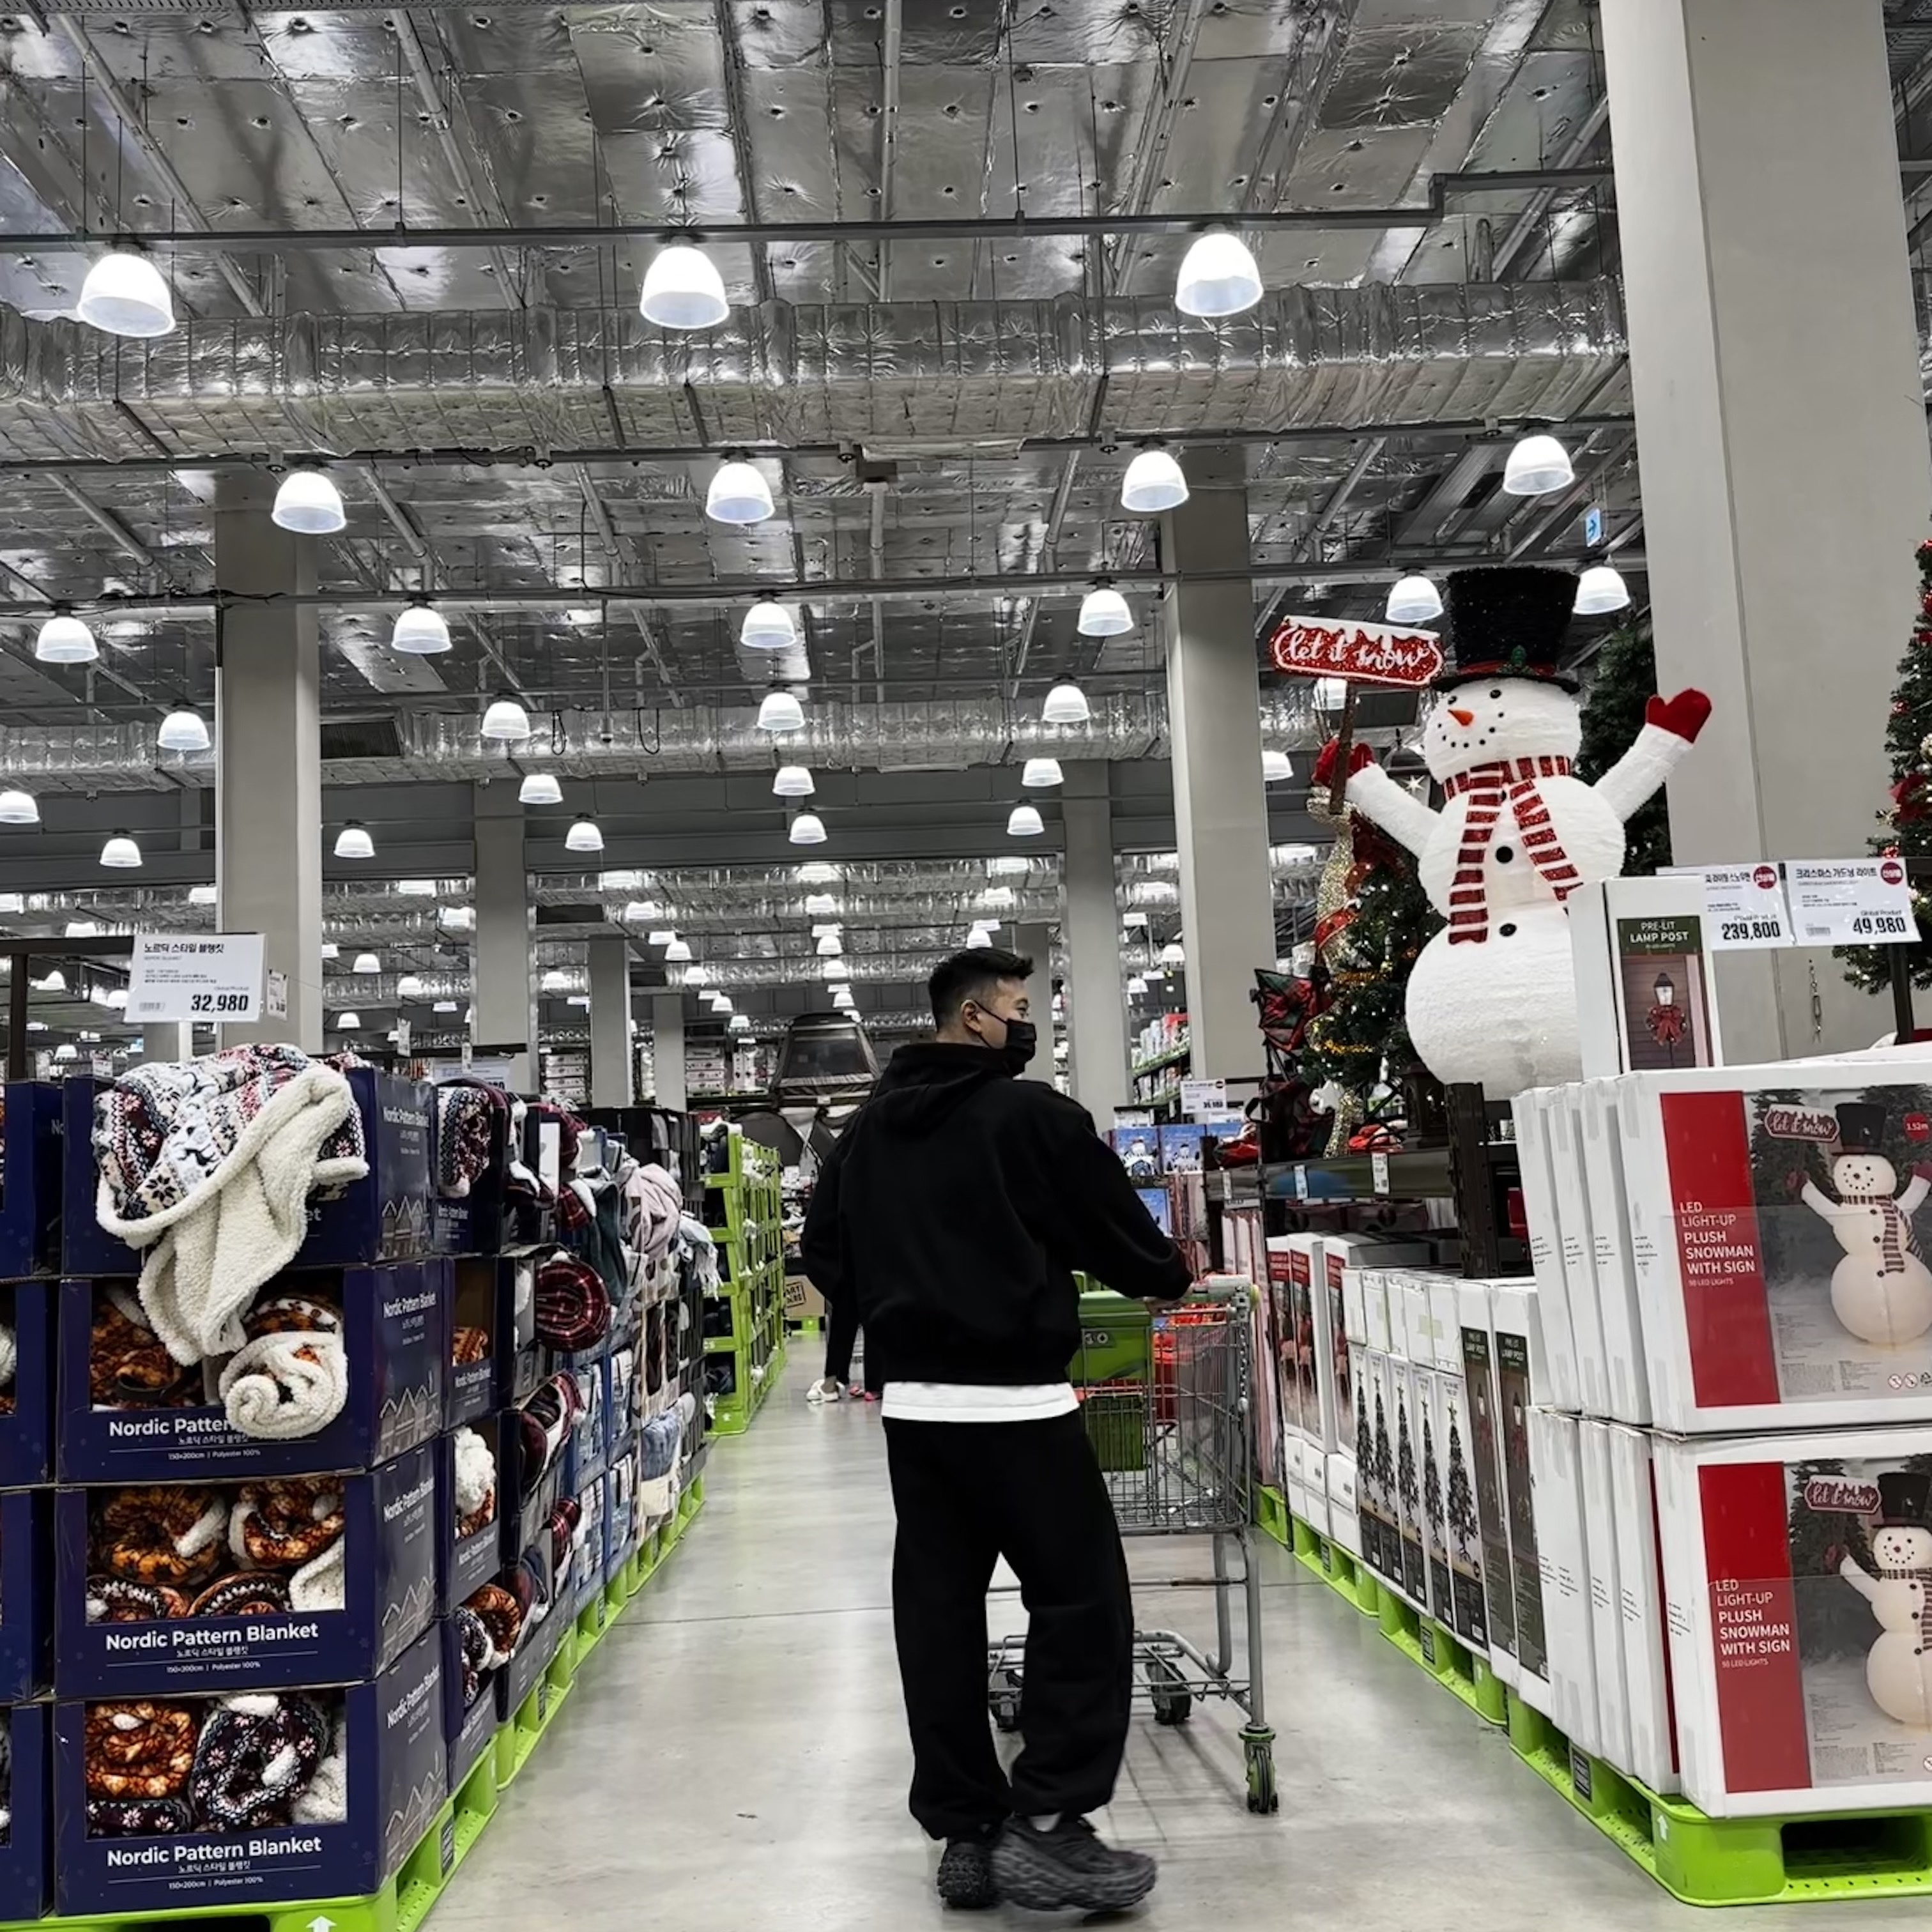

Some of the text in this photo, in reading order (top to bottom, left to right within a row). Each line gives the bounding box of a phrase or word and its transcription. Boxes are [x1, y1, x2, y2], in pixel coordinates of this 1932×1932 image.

[1284, 629, 1321, 661] let
[1354, 646, 1430, 671] snow
[1640, 921, 1675, 931] PRE-LIT
[1722, 921, 1781, 941] 239,800
[1853, 917, 1907, 935] 49,980
[1630, 931, 1689, 944] LAMP POST
[192, 994, 249, 1013] 32,980
[1680, 1202, 1703, 1214] LED
[1682, 1214, 1736, 1227] LIGHT-UP
[1683, 1231, 1726, 1244] PLUSH
[1686, 1245, 1754, 1259] SNOWMAN
[1687, 1260, 1755, 1275] WITH SIGN
[109, 1418, 234, 1437] Nordic Patter
[1715, 1579, 1738, 1591] LED
[1717, 1592, 1773, 1607] LIGHT-UP
[1719, 1610, 1762, 1623] PLUSH
[106, 1623, 319, 1650] Nordic Pattern Blanket
[1720, 1624, 1789, 1640] SNOWMAN
[1721, 1639, 1790, 1655] WITH SIGN
[107, 1837, 322, 1867] Nordic Pattern Blanket
